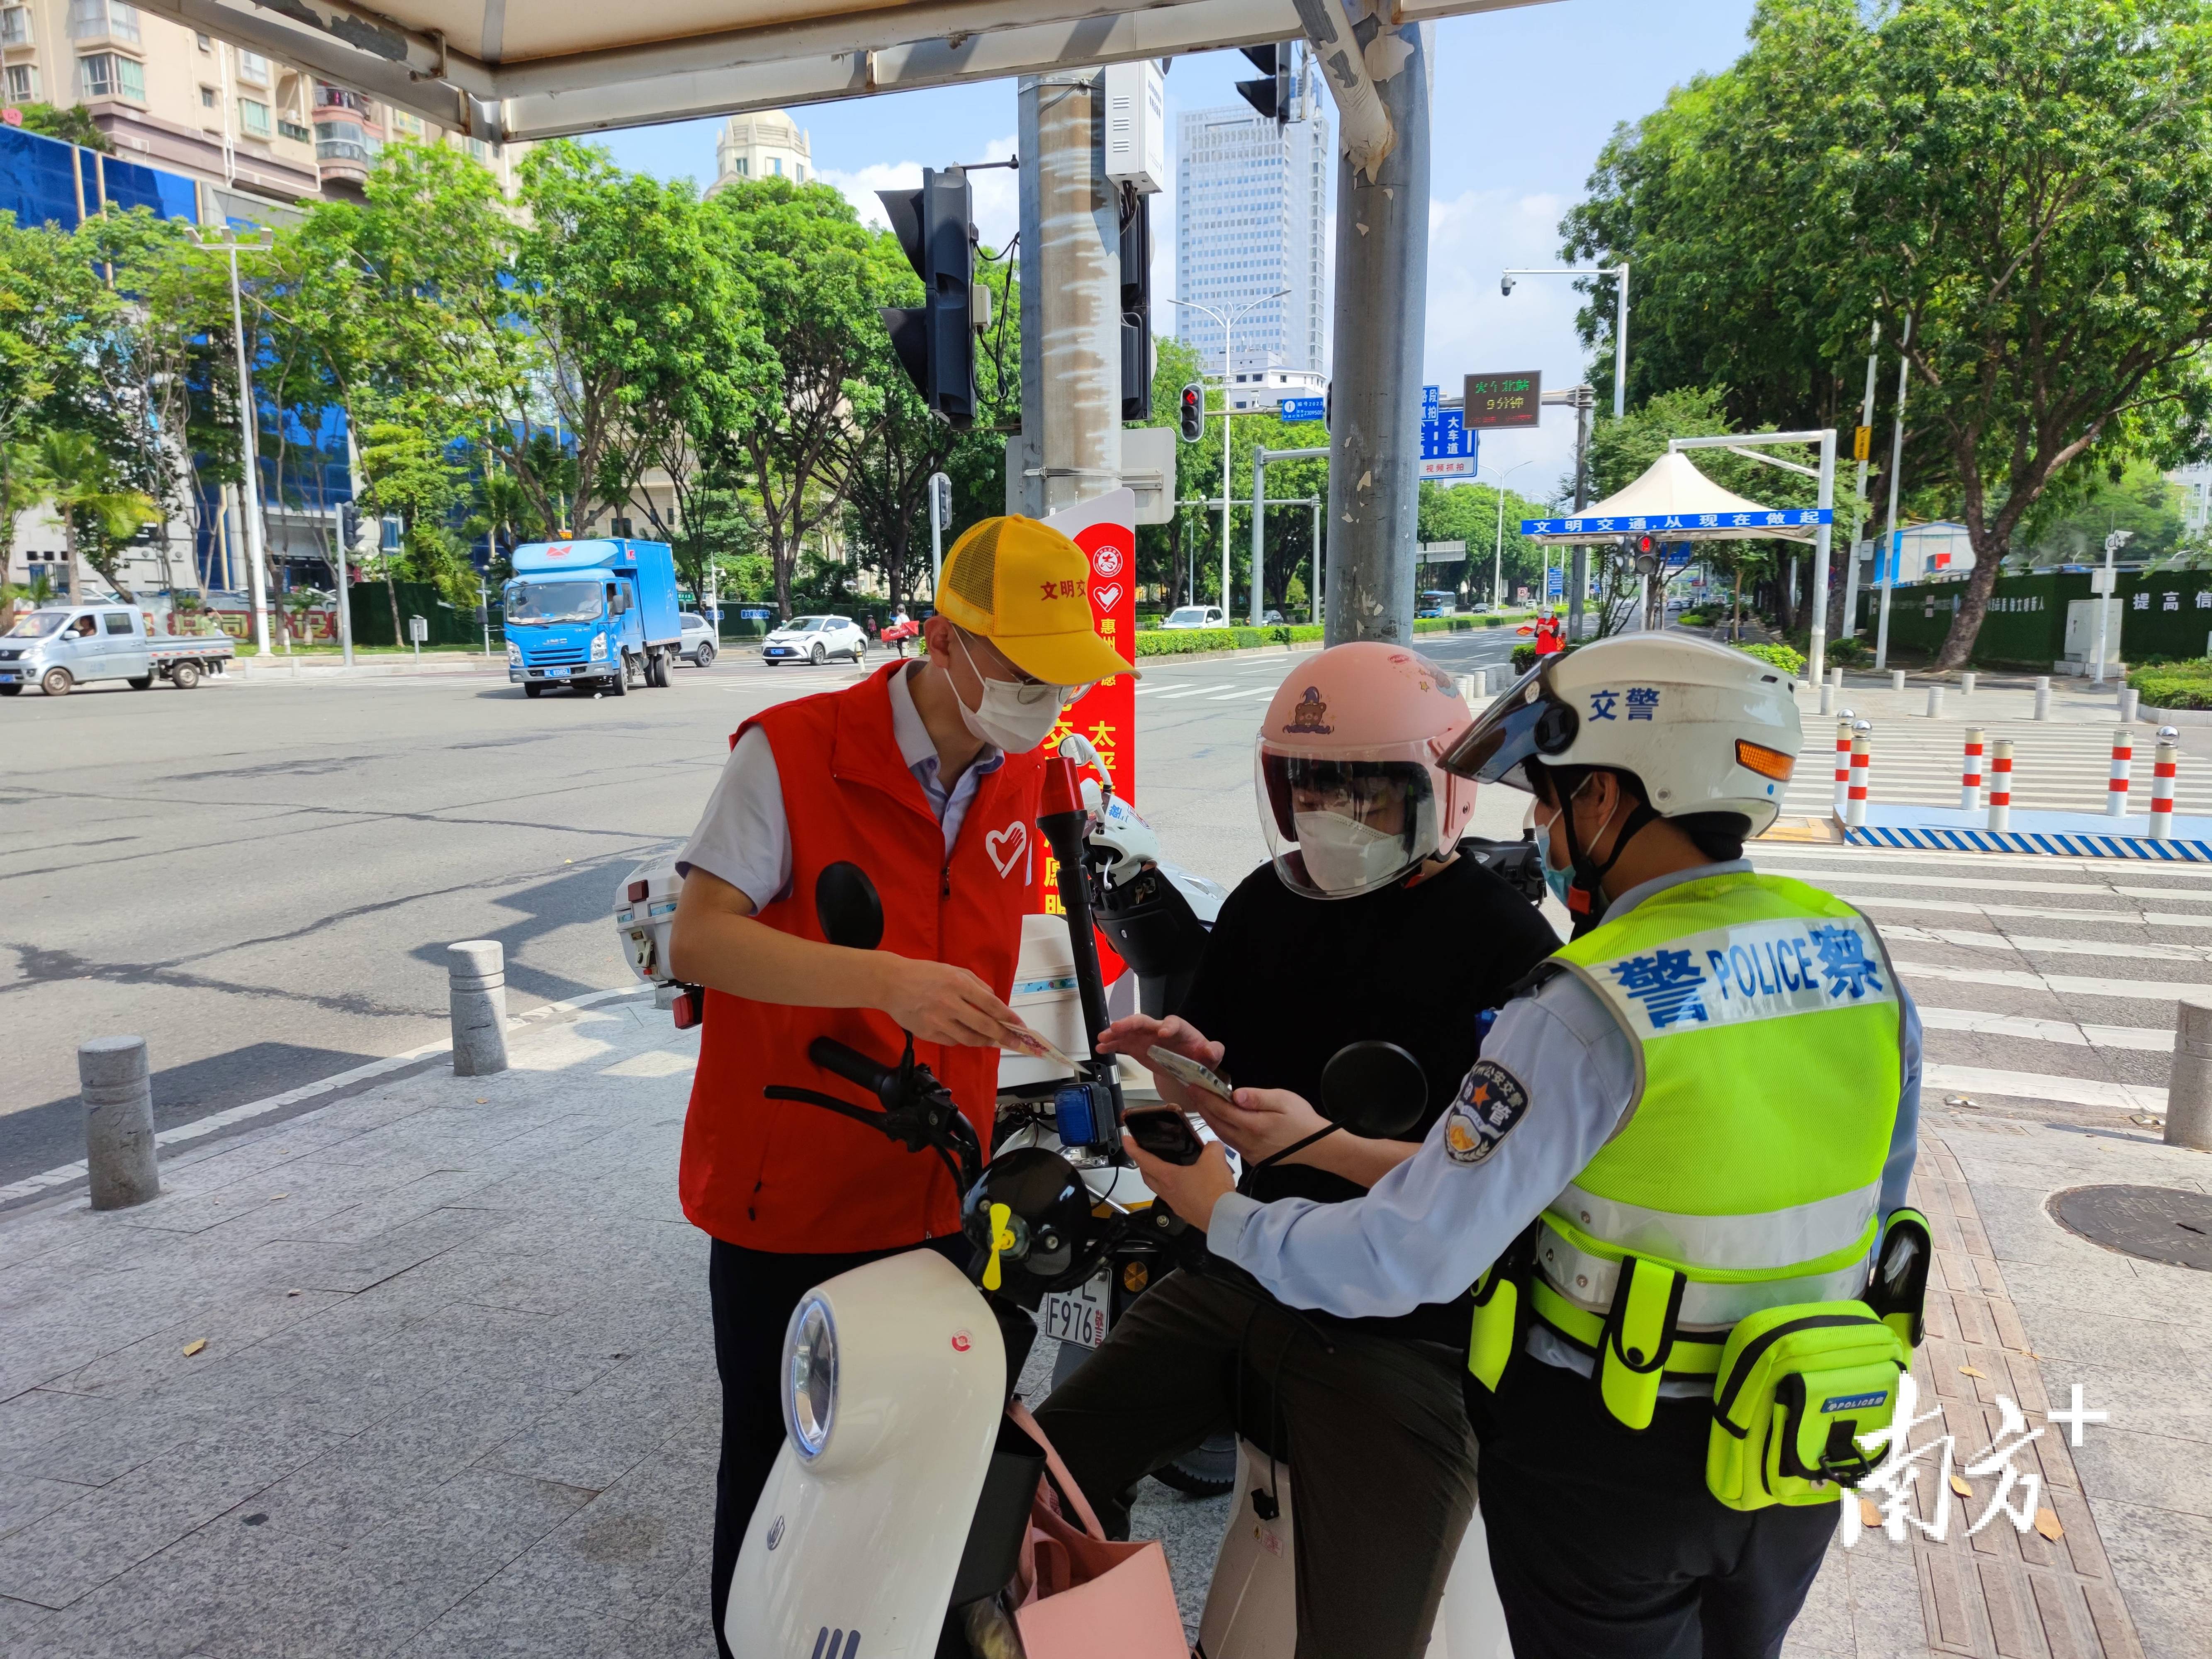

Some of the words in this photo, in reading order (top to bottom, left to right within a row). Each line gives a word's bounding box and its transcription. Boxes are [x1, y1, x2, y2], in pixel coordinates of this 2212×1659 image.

[1447, 416, 1460, 454] 大车道
[1426, 463, 1464, 473] 视频抓拍
[1588, 687, 1660, 722] 交警
[1610, 949, 1709, 1029] 警
[1706, 938, 1819, 1000] POLICE
[1810, 925, 1883, 999] 察
[1837, 1398, 1875, 1409] POLICE
